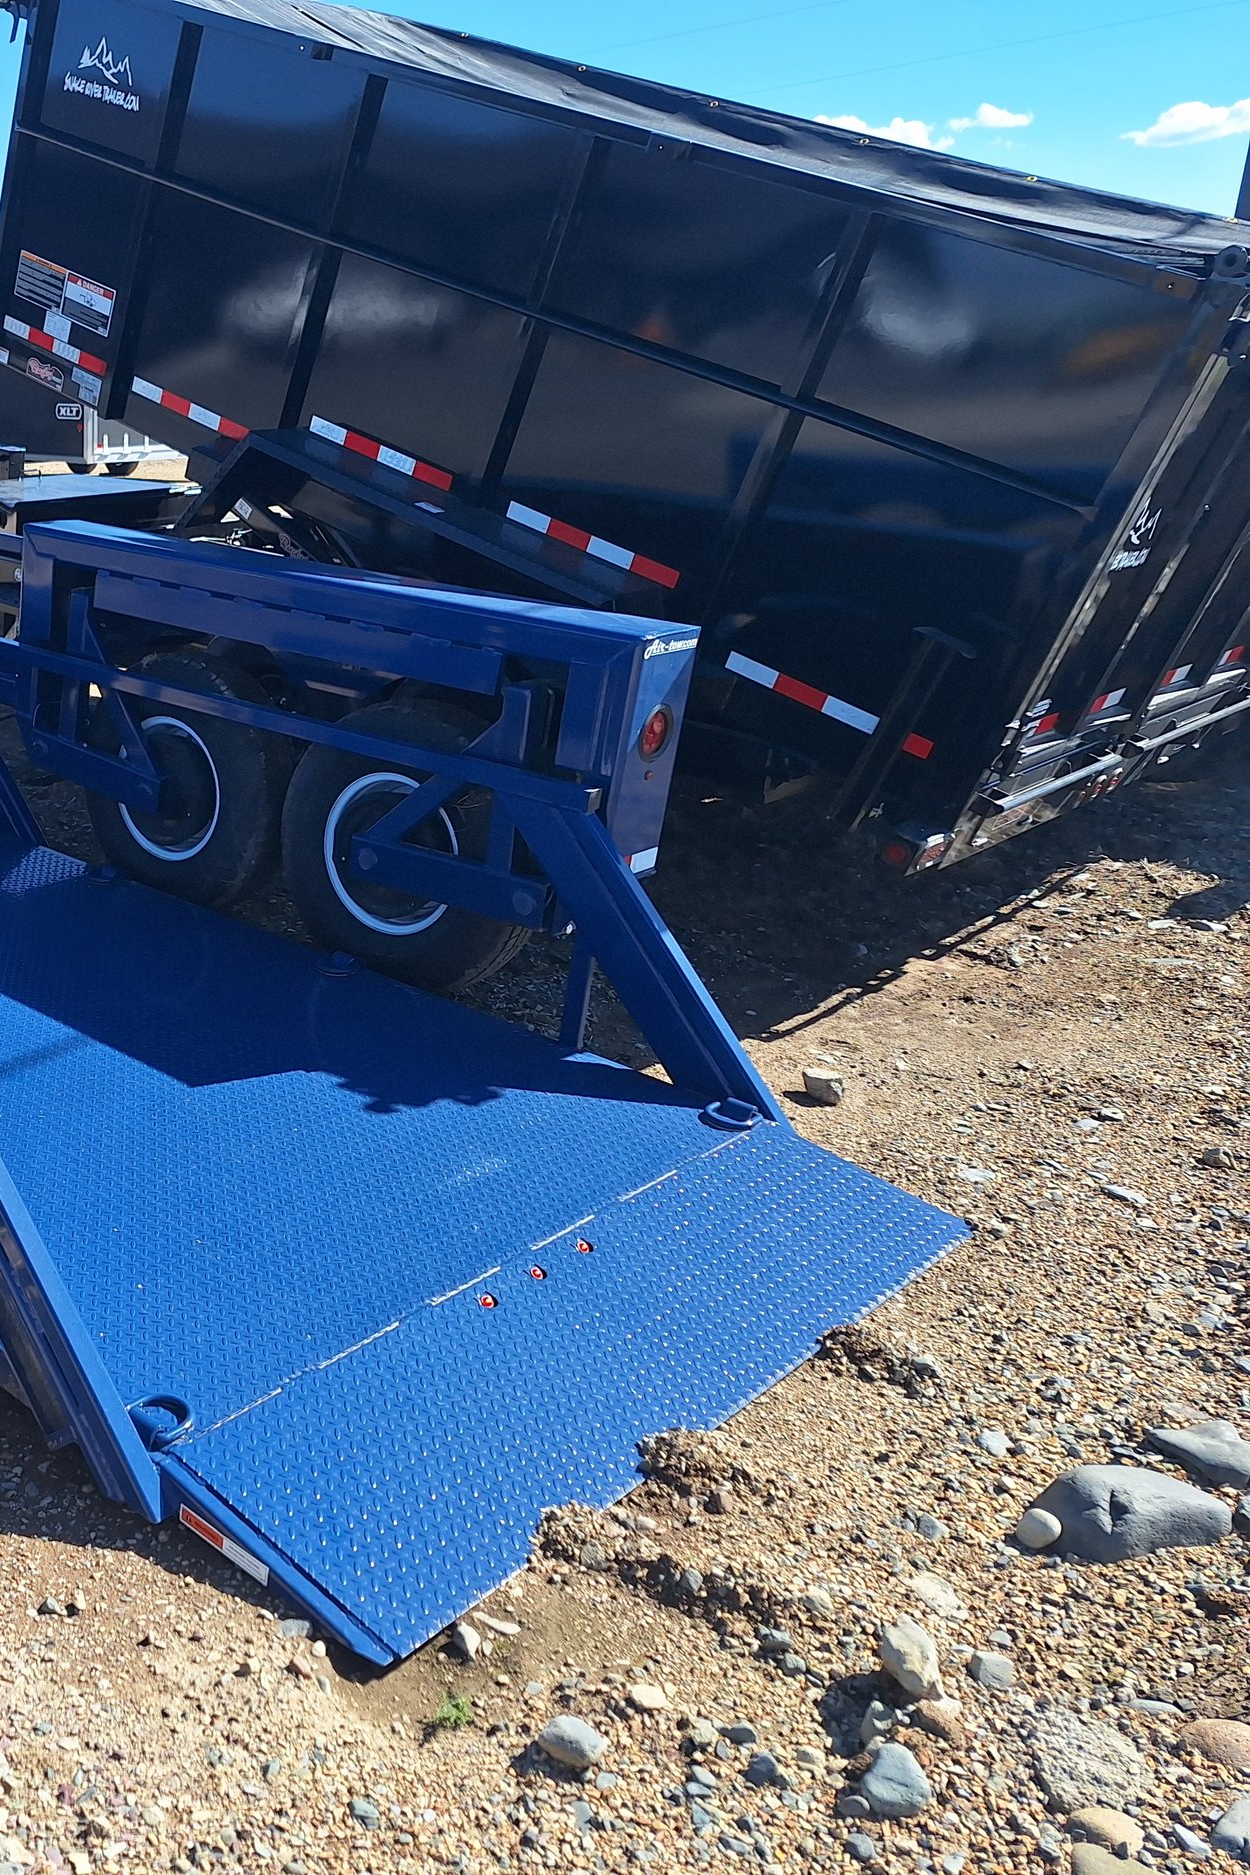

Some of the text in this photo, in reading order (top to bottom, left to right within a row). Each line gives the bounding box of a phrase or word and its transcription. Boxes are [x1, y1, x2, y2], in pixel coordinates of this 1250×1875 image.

[82, 281, 104, 296] DANGER
[59, 406, 79, 417] XLT
[644, 638, 699, 660] Air-tow.com
